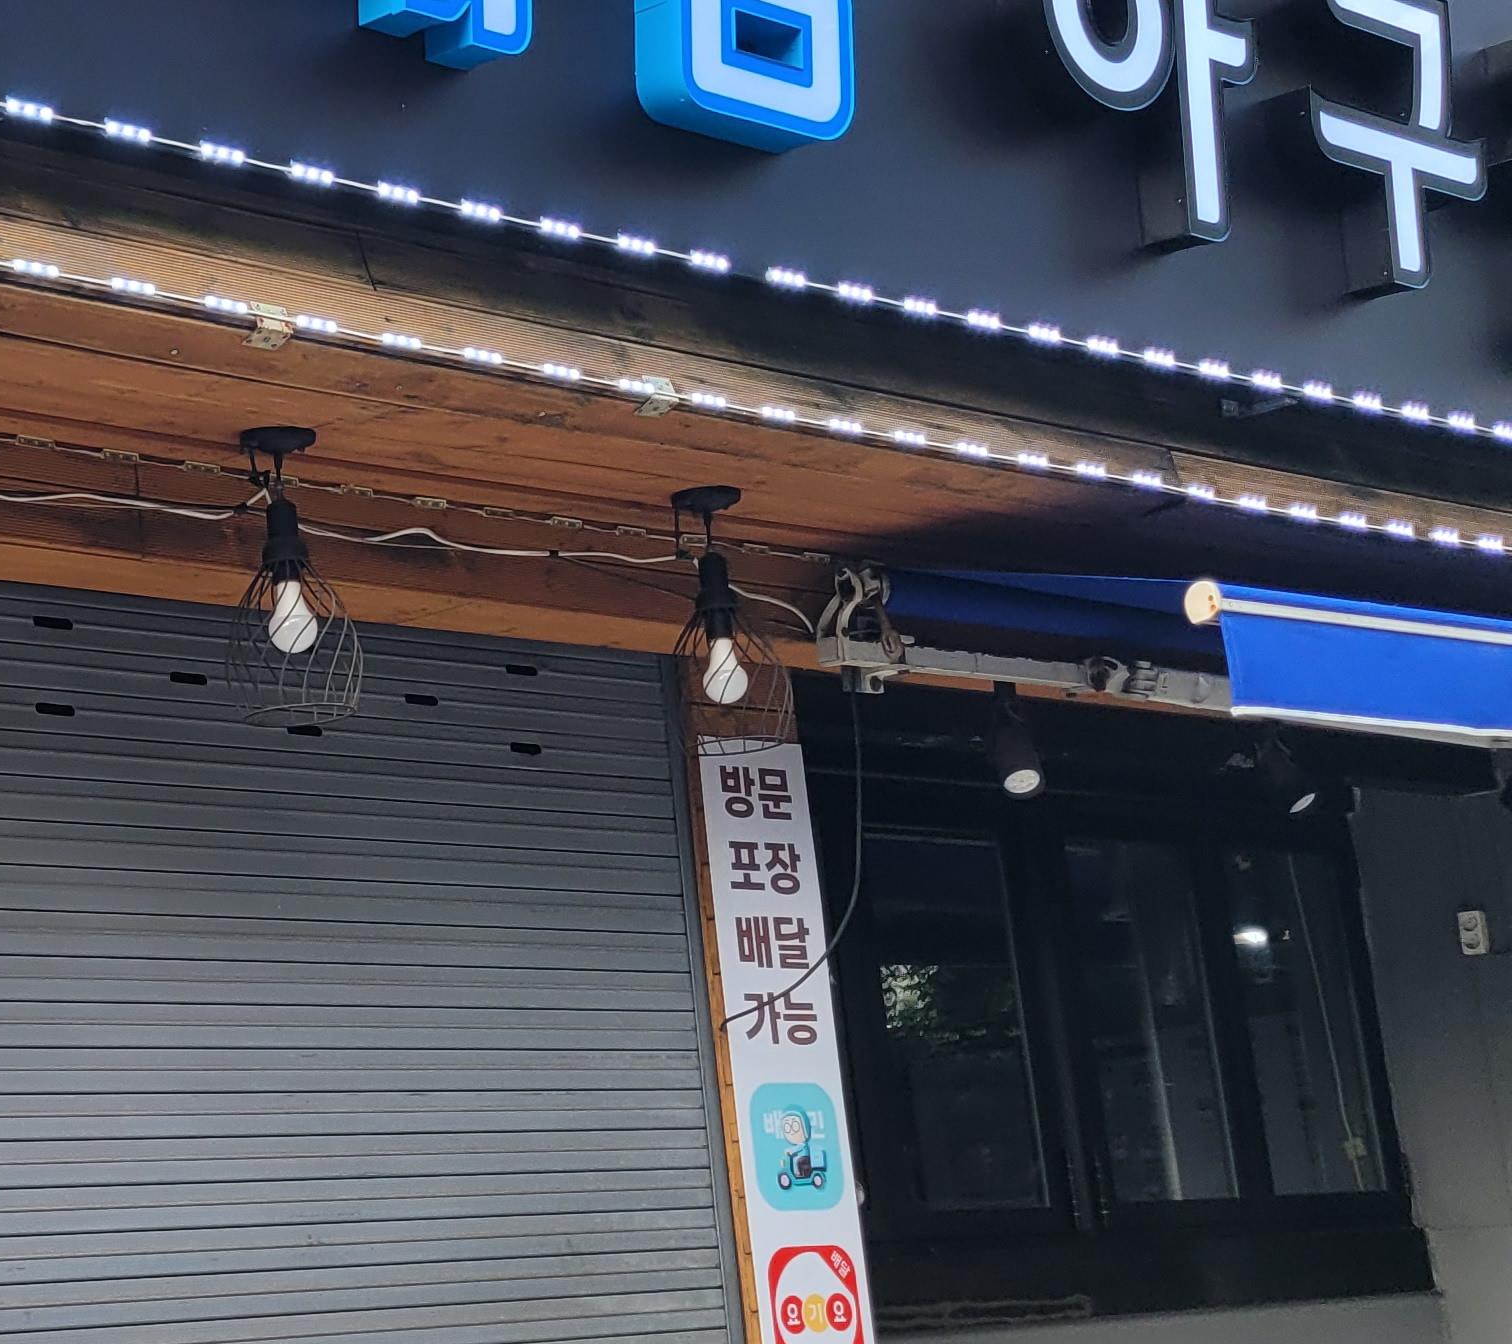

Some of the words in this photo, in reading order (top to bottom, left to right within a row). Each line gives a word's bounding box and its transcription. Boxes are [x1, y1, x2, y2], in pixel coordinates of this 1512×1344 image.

[719, 765, 793, 821] 방문
[728, 840, 801, 895] 포장
[735, 916, 810, 970] 배달
[743, 991, 818, 1045] 가능
[830, 1250, 851, 1279] 배달
[786, 1300, 847, 1326] 요기요
